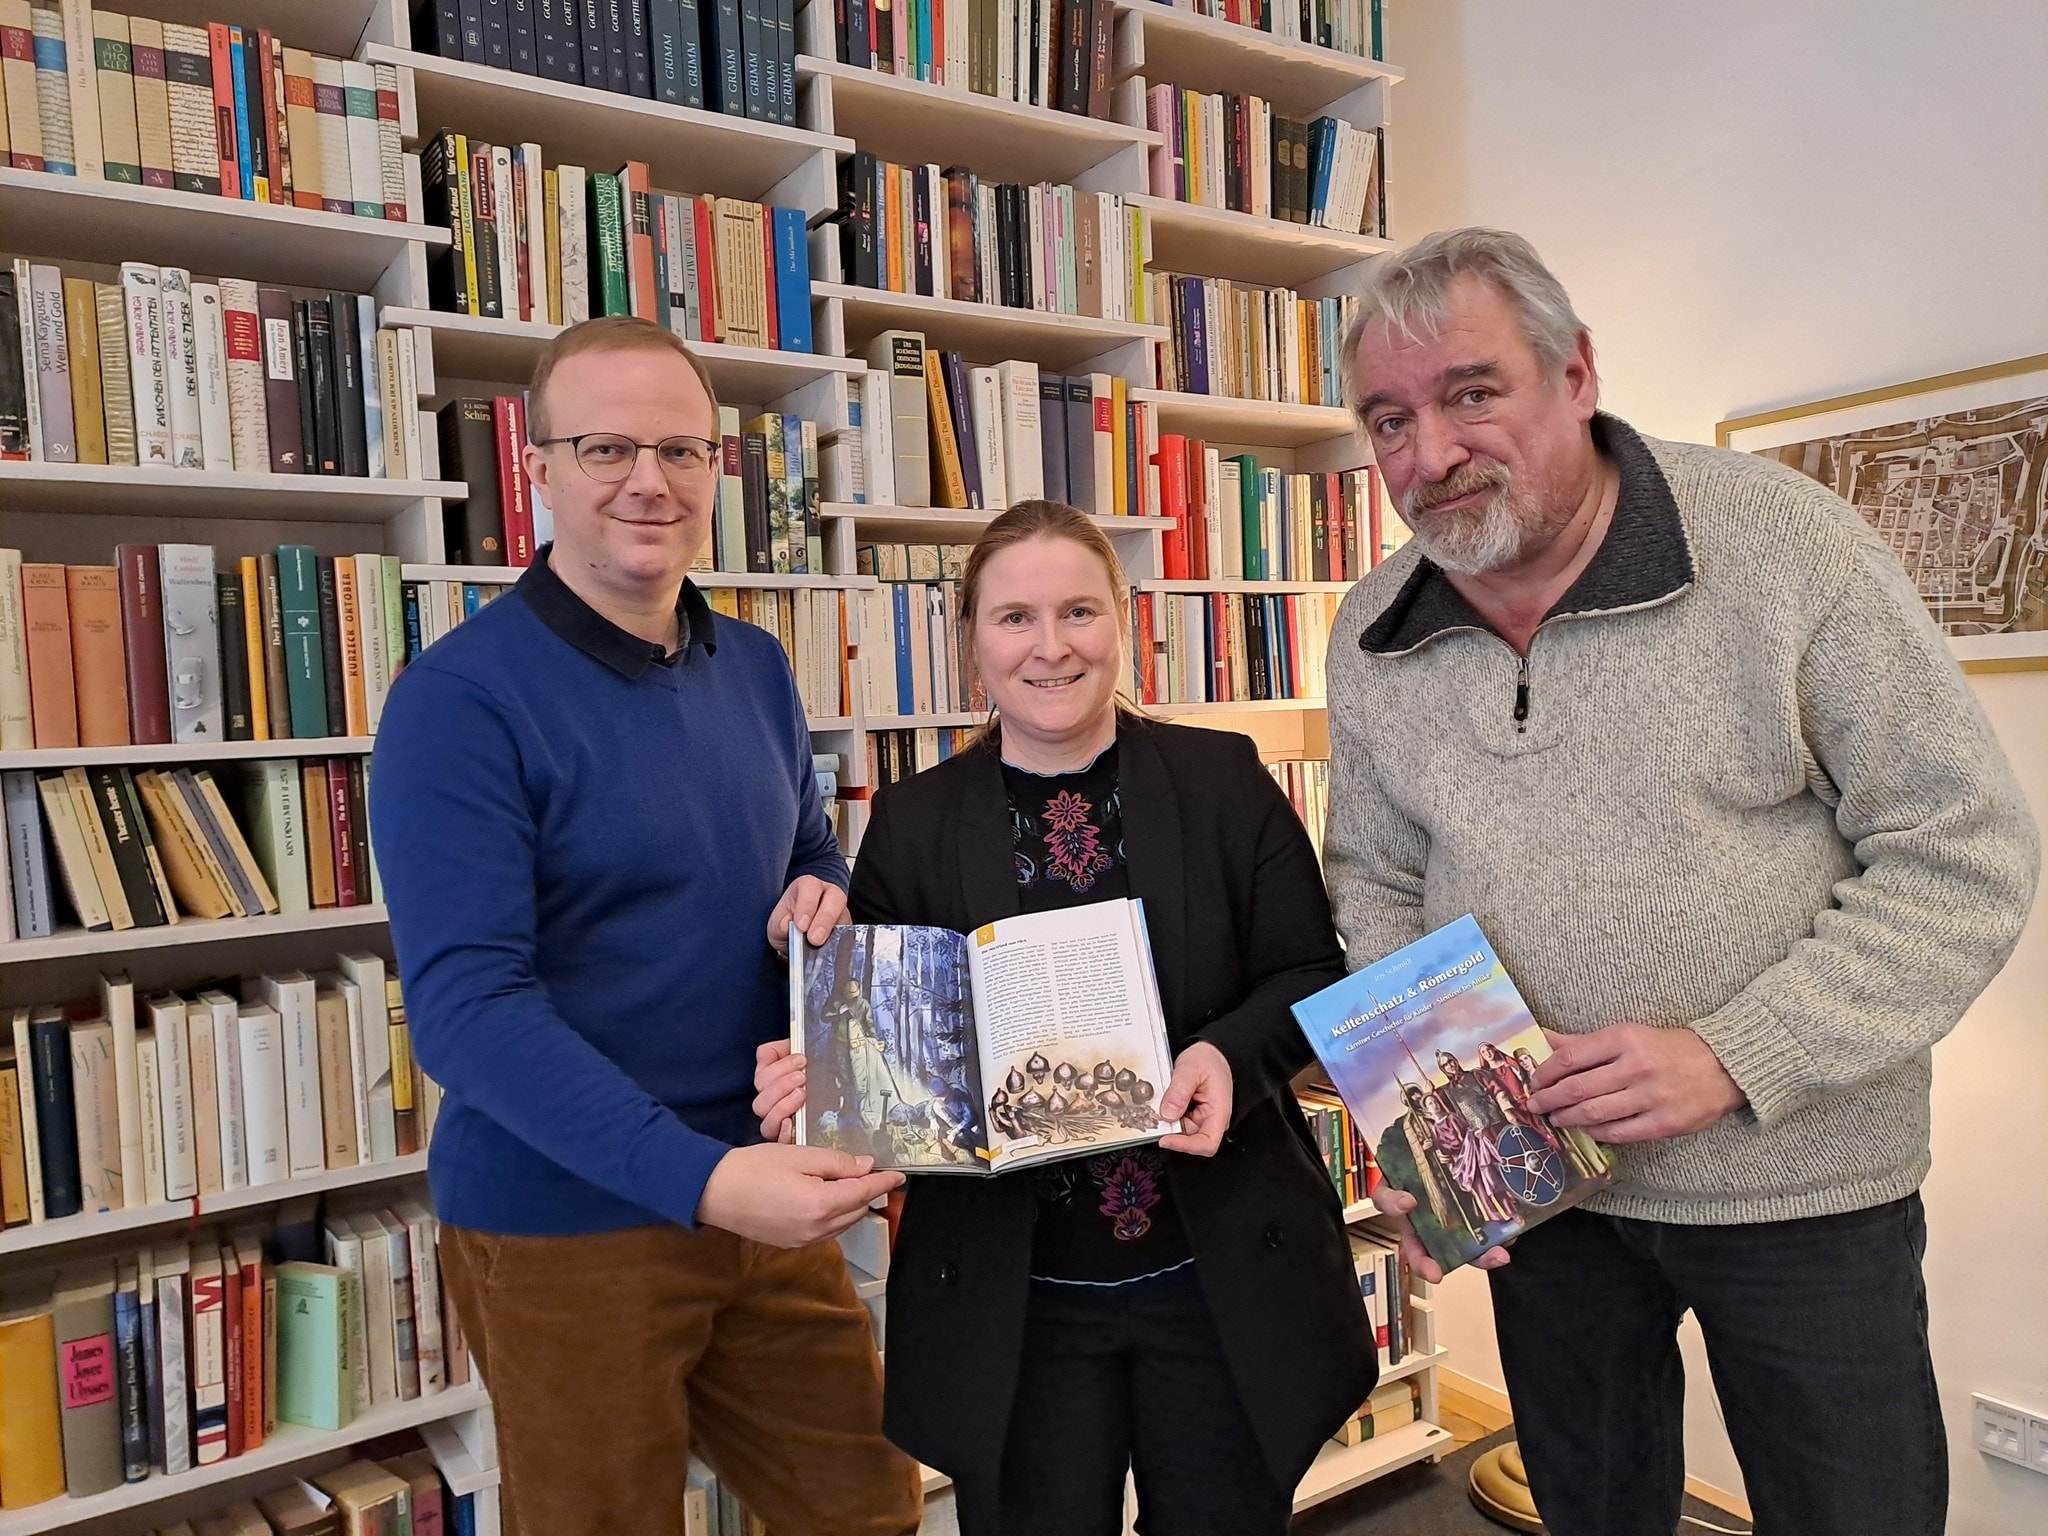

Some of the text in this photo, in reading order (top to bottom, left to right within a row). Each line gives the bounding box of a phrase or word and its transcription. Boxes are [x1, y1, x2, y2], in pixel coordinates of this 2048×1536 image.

[103, 51, 128, 63] PHO
[107, 43, 123, 53] SO
[662, 33, 675, 80] GRIMM
[686, 41, 698, 87] GRIMM
[104, 61, 128, 72] KLES
[726, 48, 738, 93] GRIMM
[748, 51, 760, 96] GRIMM
[766, 58, 776, 103] GRIMM
[782, 61, 793, 105] GRIMM
[445, 133, 463, 251] Antonin Artaud Van Gogh
[460, 170, 471, 233] FLÄCHENLAND
[479, 159, 489, 215] KADER ABDOLAH
[603, 178, 612, 197] DES
[681, 207, 696, 290] SCHWERKRAFT
[35, 289, 52, 372] Sema Kaygusuz
[50, 291, 67, 374] Wein und Gold
[132, 295, 146, 356] ARAVIND ADIGA
[165, 299, 178, 359] ARAVIND ADIGA
[148, 297, 167, 428] ZWISCHEN DEN ATTENTATEN
[180, 301, 197, 397] DER WEISSE TIGER
[276, 322, 289, 376] Jean Améry
[387, 356, 395, 381] TALMUD
[464, 410, 491, 421] Schira
[53, 443, 69, 455] SV
[391, 412, 401, 456] GESCHICHTEN
[944, 436, 953, 456] Rasch
[513, 472, 521, 491] Anders
[29, 577, 56, 585] KRAUS
[80, 580, 107, 588] KRAUS
[82, 574, 103, 582] KARL
[320, 569, 333, 605] ruhm
[9, 590, 17, 625] Leichtigkeit
[268, 576, 281, 646] Der Fliegenpalast
[342, 573, 358, 677] KURZECK OKTOBER
[406, 601, 417, 637] and Blue
[11, 627, 20, 663] unerträgliche
[372, 636, 381, 668] KUNDERA
[13, 665, 21, 676] Die
[375, 670, 383, 692] MILAN
[106, 786, 130, 843] Theater heute
[339, 831, 349, 851] Demetz
[341, 852, 350, 867] Peter
[1385, 958, 1413, 974] Schmidt
[1330, 950, 1487, 1038] Keltenschatz & Römergold
[1344, 1035, 1372, 1052] Kärntner
[1371, 1018, 1404, 1039] Geschichte
[1403, 1013, 1414, 1025] für
[1412, 1003, 1434, 1019] Kinder
[1436, 988, 1464, 1005] Steinzeit
[1471, 972, 1492, 989] Antike
[71, 1345, 104, 1362] James
[73, 1363, 102, 1382] Joyce
[126, 1369, 136, 1383] Das
[70, 1381, 109, 1401] Ulysses
[129, 1411, 141, 1440] Michael
